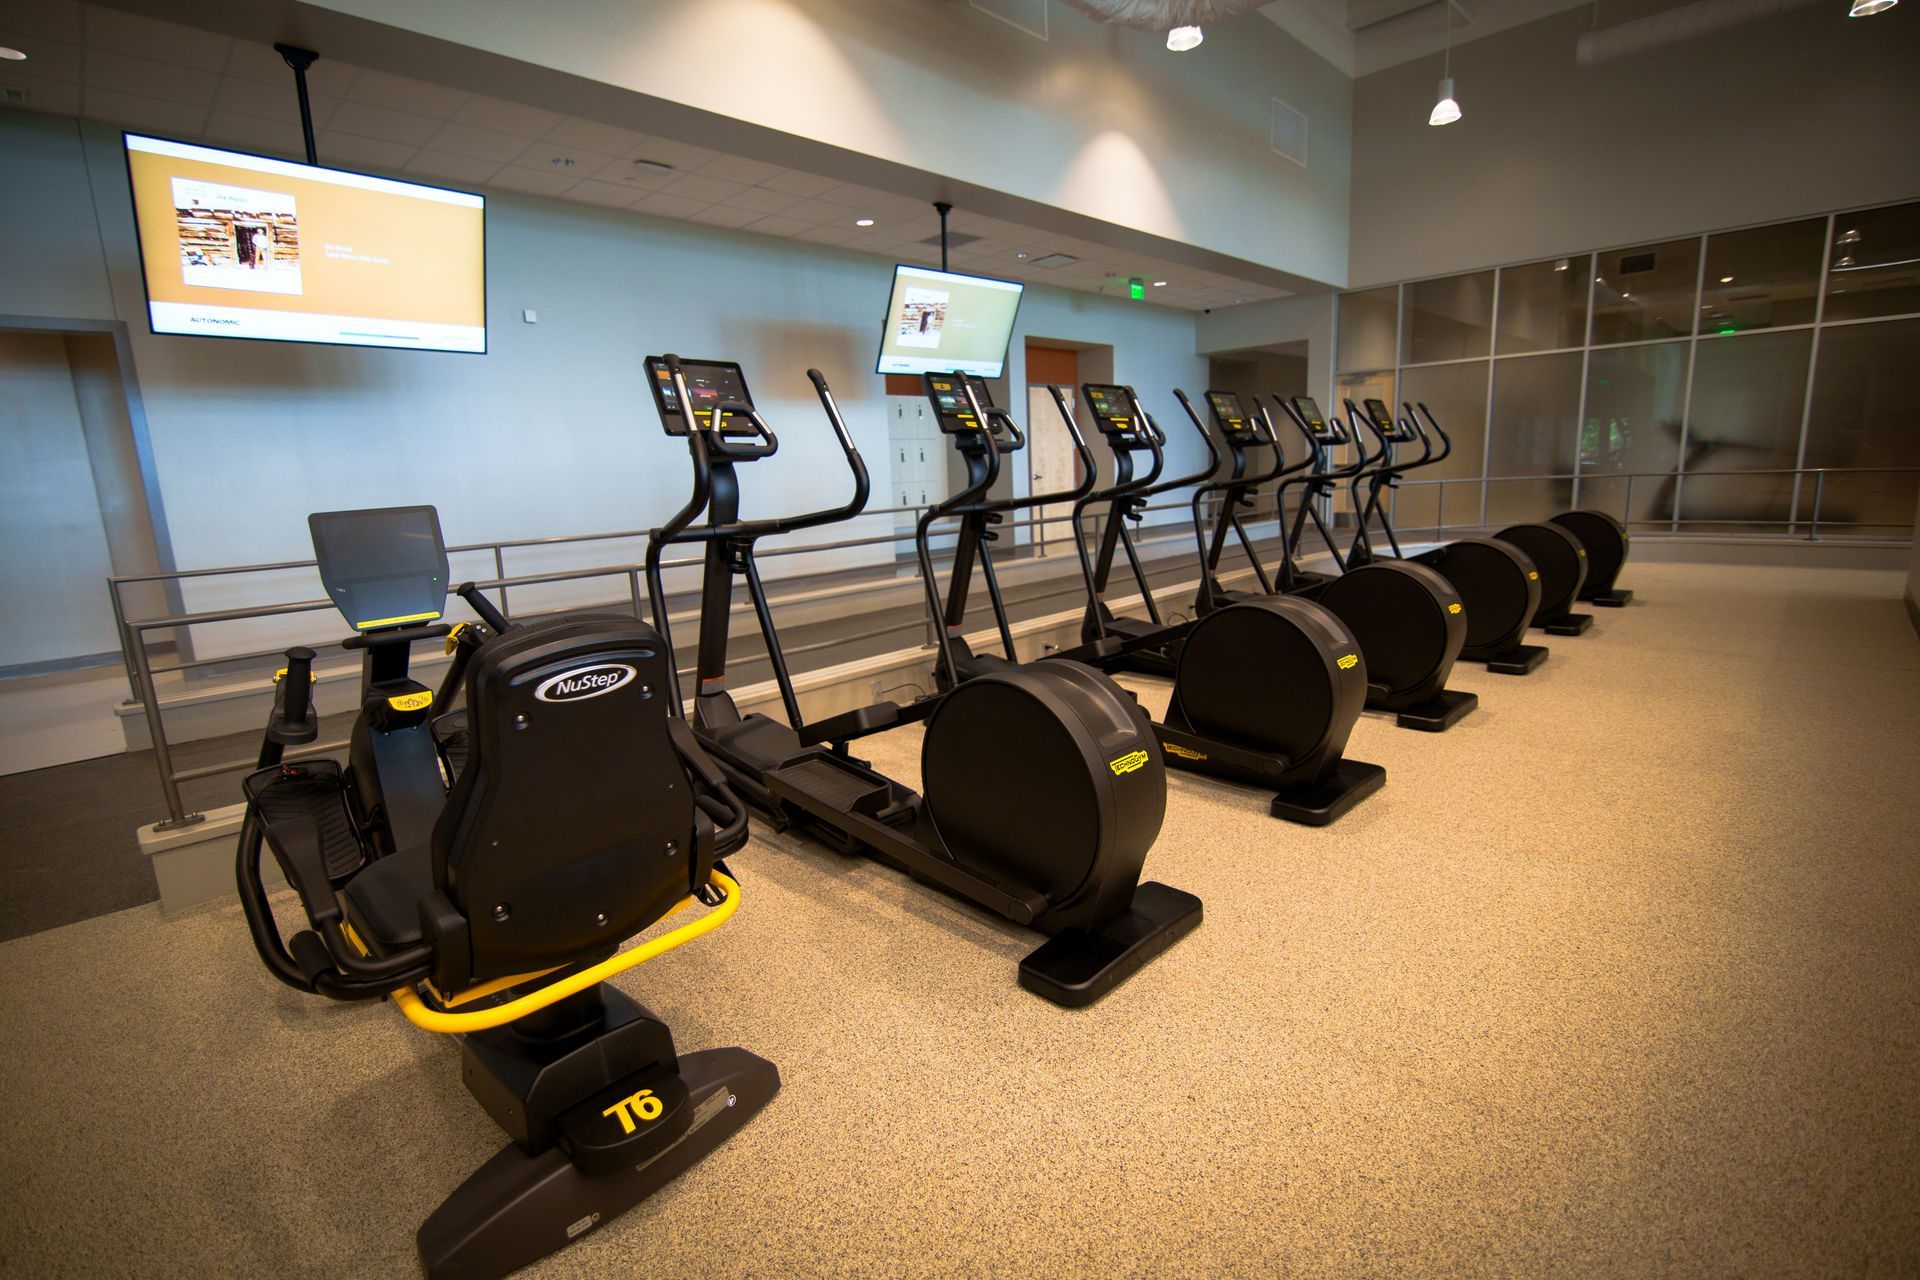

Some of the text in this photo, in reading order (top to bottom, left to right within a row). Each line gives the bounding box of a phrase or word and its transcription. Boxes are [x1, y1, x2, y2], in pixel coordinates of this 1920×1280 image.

[190, 317, 241, 326] AUTONOMIC
[556, 672, 619, 696] NuStep
[1111, 752, 1147, 772] TECHNOGYM
[602, 1089, 664, 1134] T6
